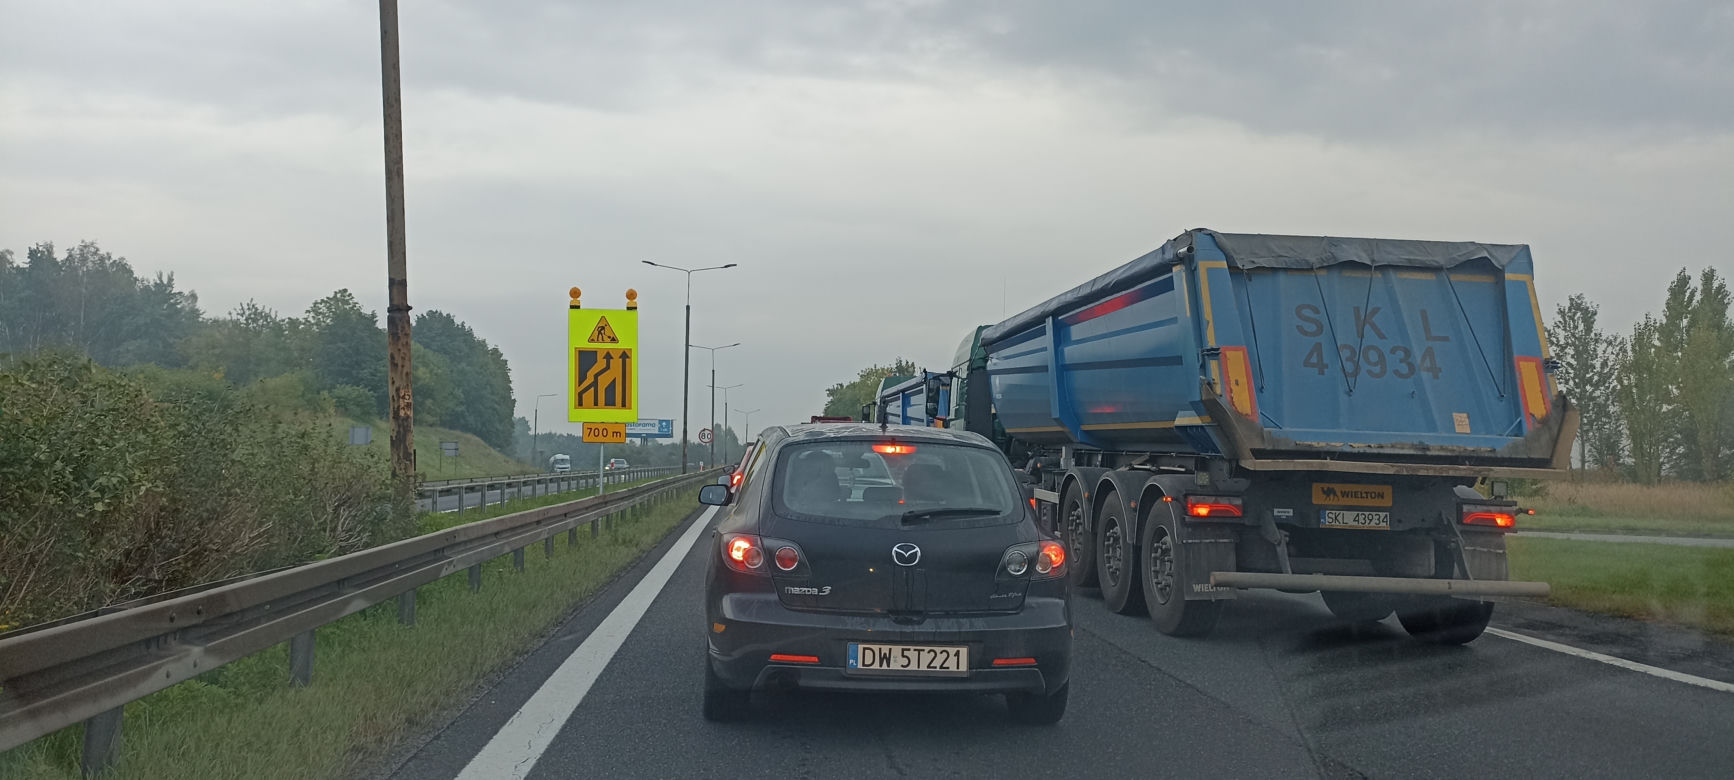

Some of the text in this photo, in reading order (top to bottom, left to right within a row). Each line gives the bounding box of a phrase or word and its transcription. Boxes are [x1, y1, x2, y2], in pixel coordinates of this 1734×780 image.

[1303, 342, 1442, 379] 43934
[587, 427, 608, 438] 700
[700, 432, 712, 440] 80
[1340, 490, 1385, 500] WIELTON
[1327, 511, 1389, 526] SKL 43934
[819, 586, 832, 596] 3
[861, 646, 961, 670] DW 5T221
